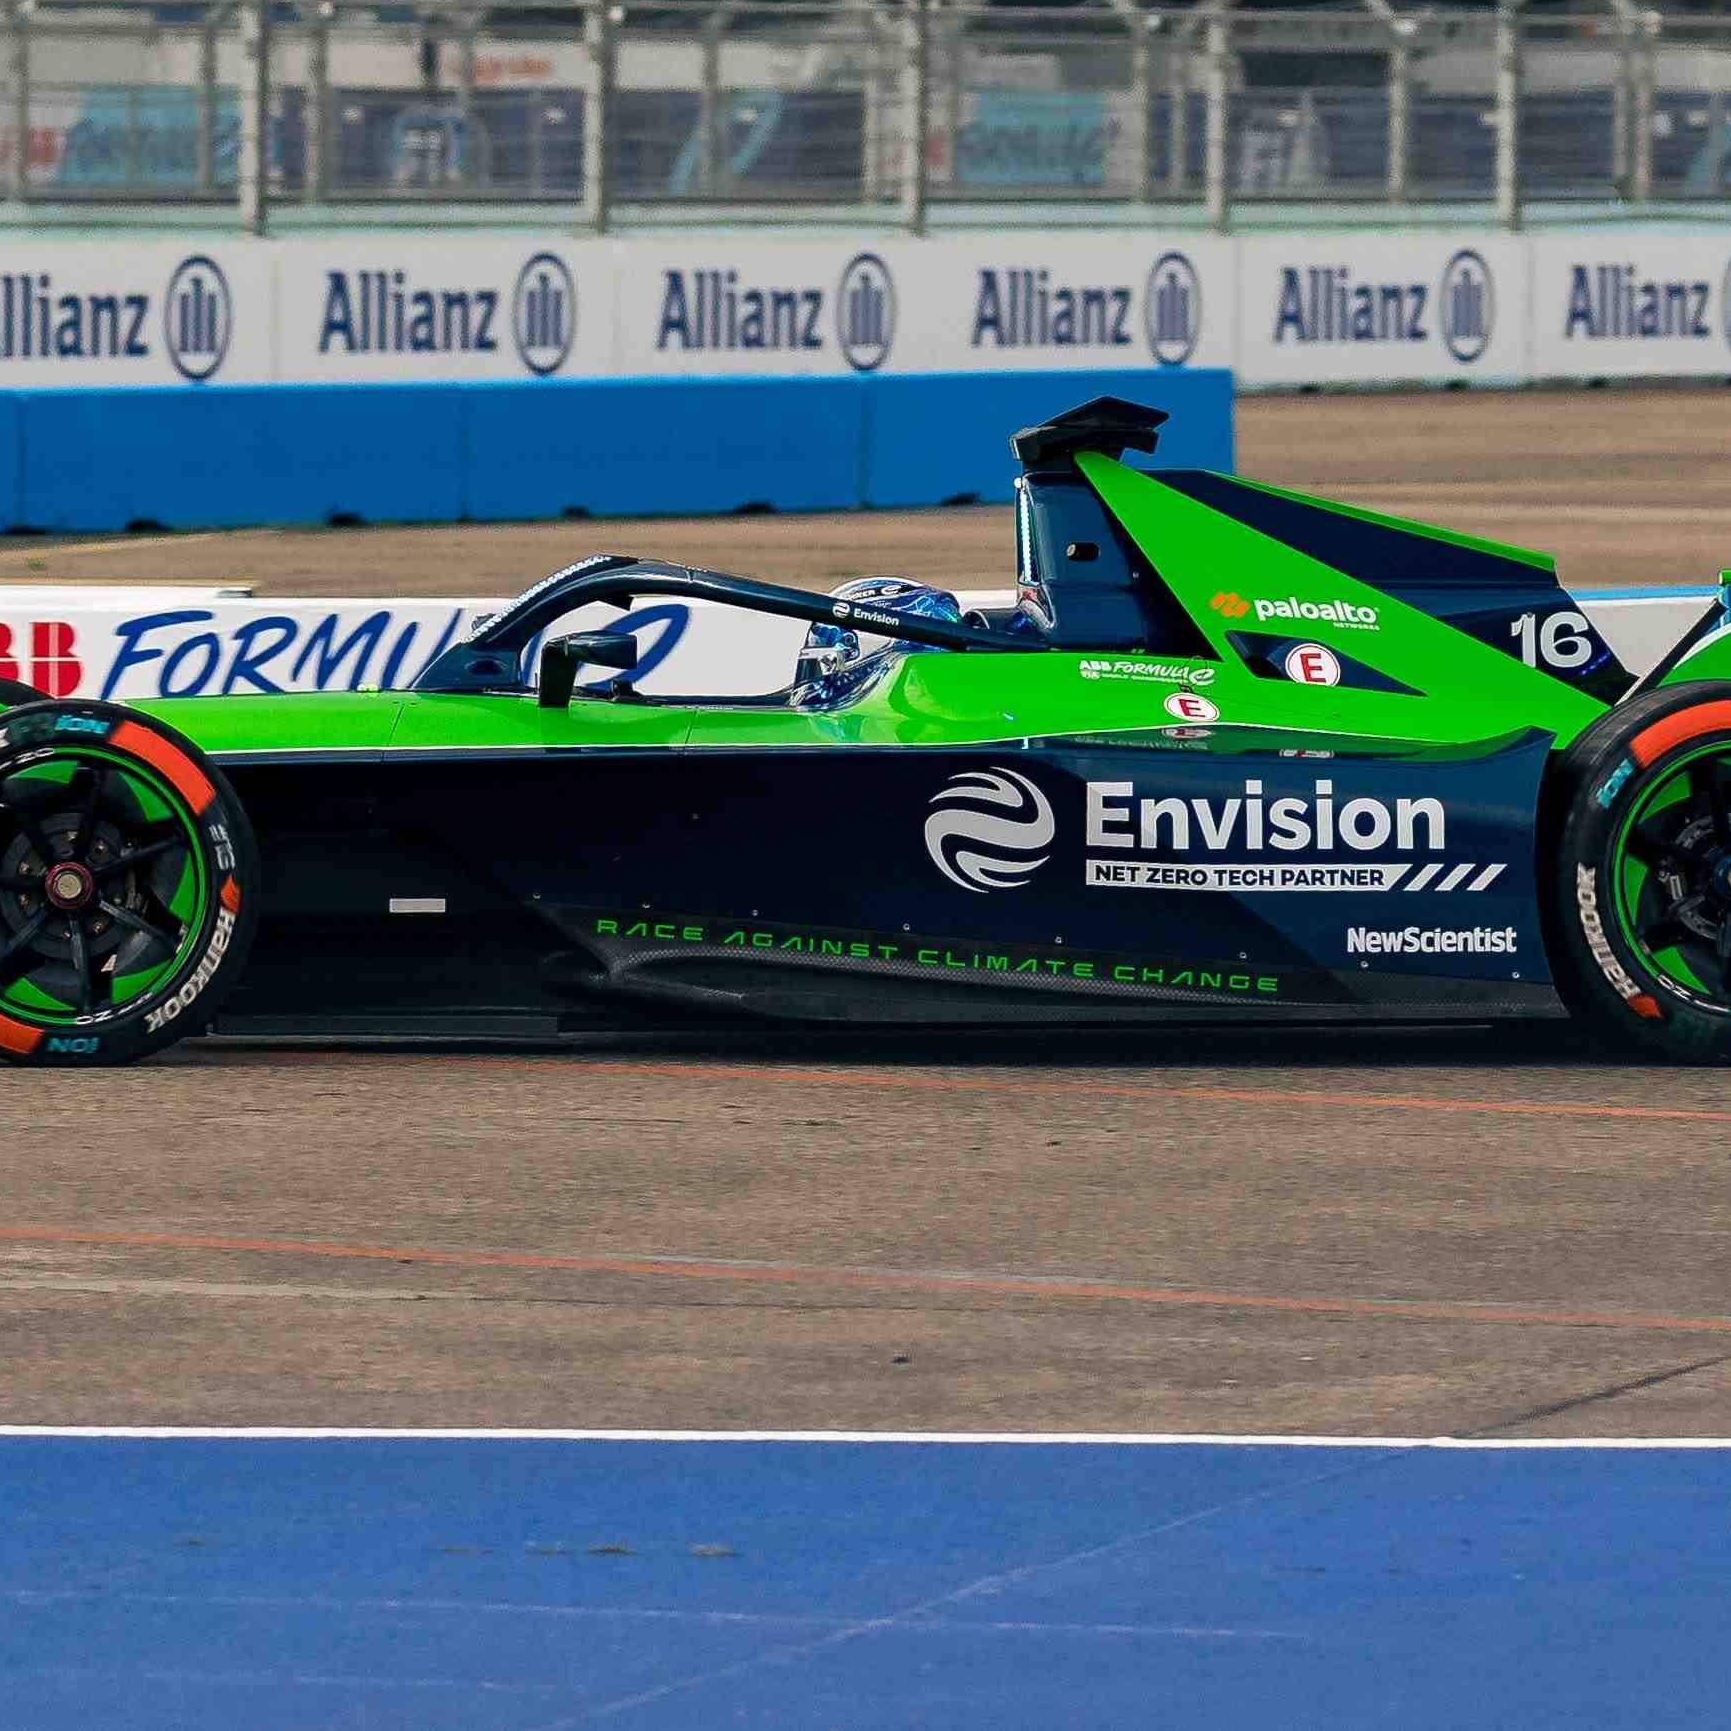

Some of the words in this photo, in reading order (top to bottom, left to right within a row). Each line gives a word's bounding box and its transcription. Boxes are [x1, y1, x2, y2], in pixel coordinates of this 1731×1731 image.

[319, 271, 498, 355] Allianz
[656, 269, 824, 351] Allianz
[971, 269, 1132, 348] Allianz
[1274, 267, 1429, 342] Allianz
[1564, 264, 1711, 339] Allianz
[853, 607, 900, 626] Envision
[1254, 596, 1377, 624] paloalto
[1510, 611, 1594, 670] 16
[1085, 779, 1446, 851] Envision
[1094, 864, 1139, 882] NET
[1146, 868, 1207, 886] ZERO
[1214, 869, 1275, 887] TECH
[1282, 870, 1384, 887] PARTNER
[597, 918, 705, 943] RACE
[725, 931, 900, 962] AGAINST
[917, 949, 1095, 979] CLIMATE
[1114, 966, 1279, 993] CHANGE
